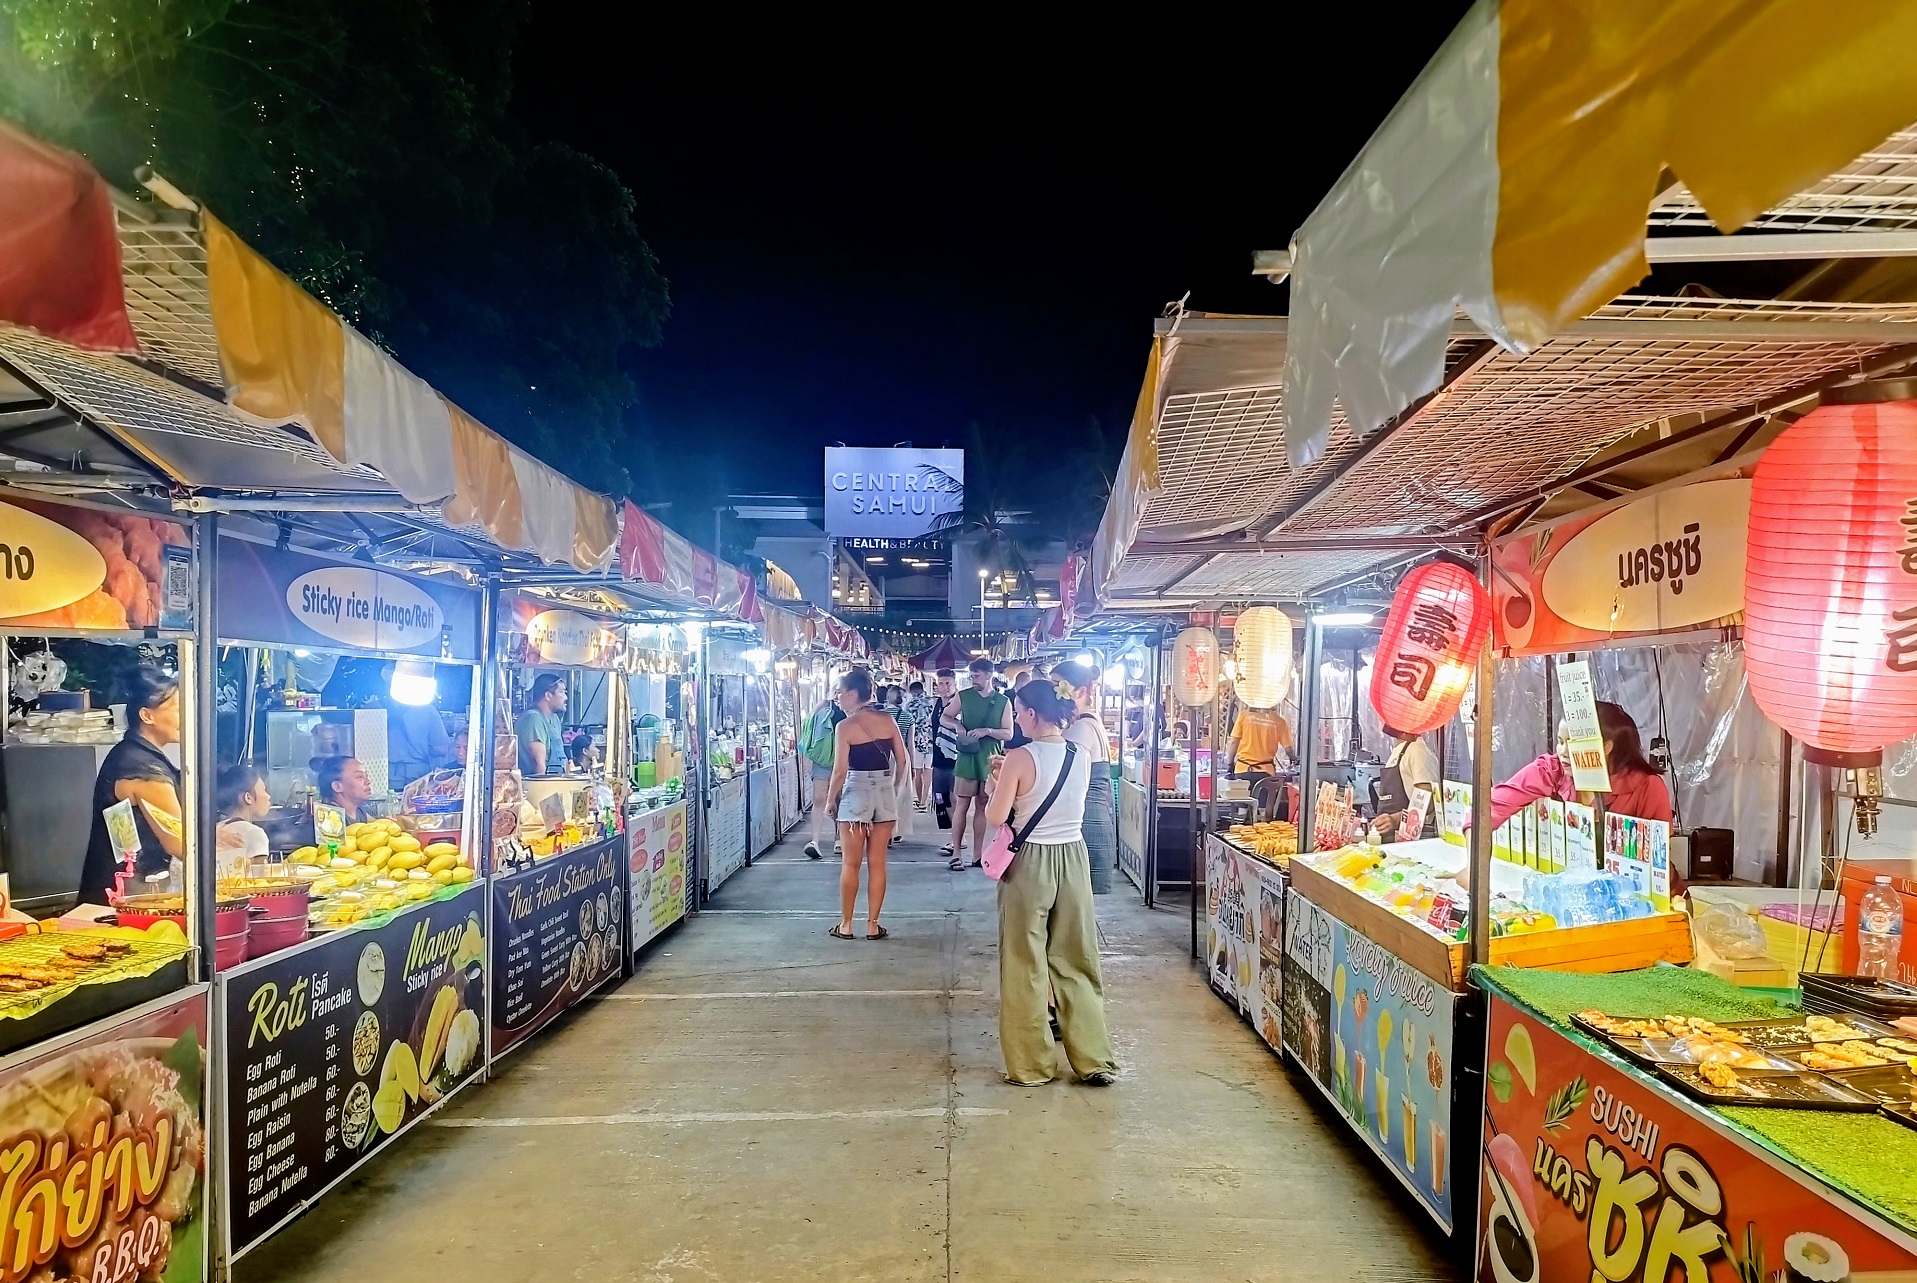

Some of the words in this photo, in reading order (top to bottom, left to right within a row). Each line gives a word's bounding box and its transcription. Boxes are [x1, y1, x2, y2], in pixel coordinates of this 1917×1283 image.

[852, 495, 938, 515] SAMUI
[303, 584, 341, 623] Sticky
[346, 591, 369, 619] rice
[373, 596, 434, 631] Mango/Roti
[1572, 752, 1603, 769] WATER
[508, 883, 534, 924] Thai
[536, 866, 562, 911] Food
[562, 861, 596, 898] Station
[596, 848, 616, 887] Only
[403, 917, 463, 981] Mango
[407, 969, 428, 994] Sticky
[430, 962, 443, 983] rice
[247, 975, 308, 1049] Roti
[311, 986, 352, 1020] Pancake
[507, 999, 515, 1009] Rice
[246, 1062, 261, 1082] Egg
[265, 1049, 282, 1072] Roti
[246, 1075, 278, 1105] Banana
[280, 1063, 297, 1085] Roti
[246, 1103, 269, 1127] Plain
[271, 1093, 288, 1115] with
[290, 1075, 317, 1100] Nutella
[247, 1130, 263, 1150] Egg
[265, 1111, 292, 1140] Raisin
[1590, 1085, 1659, 1161] SUSHI
[247, 1152, 263, 1172] Egg
[266, 1133, 295, 1160] Banana
[247, 1175, 263, 1195] Egg
[266, 1153, 295, 1183] Cheese
[248, 1190, 279, 1218] Banana
[281, 1165, 308, 1195] Nutella
